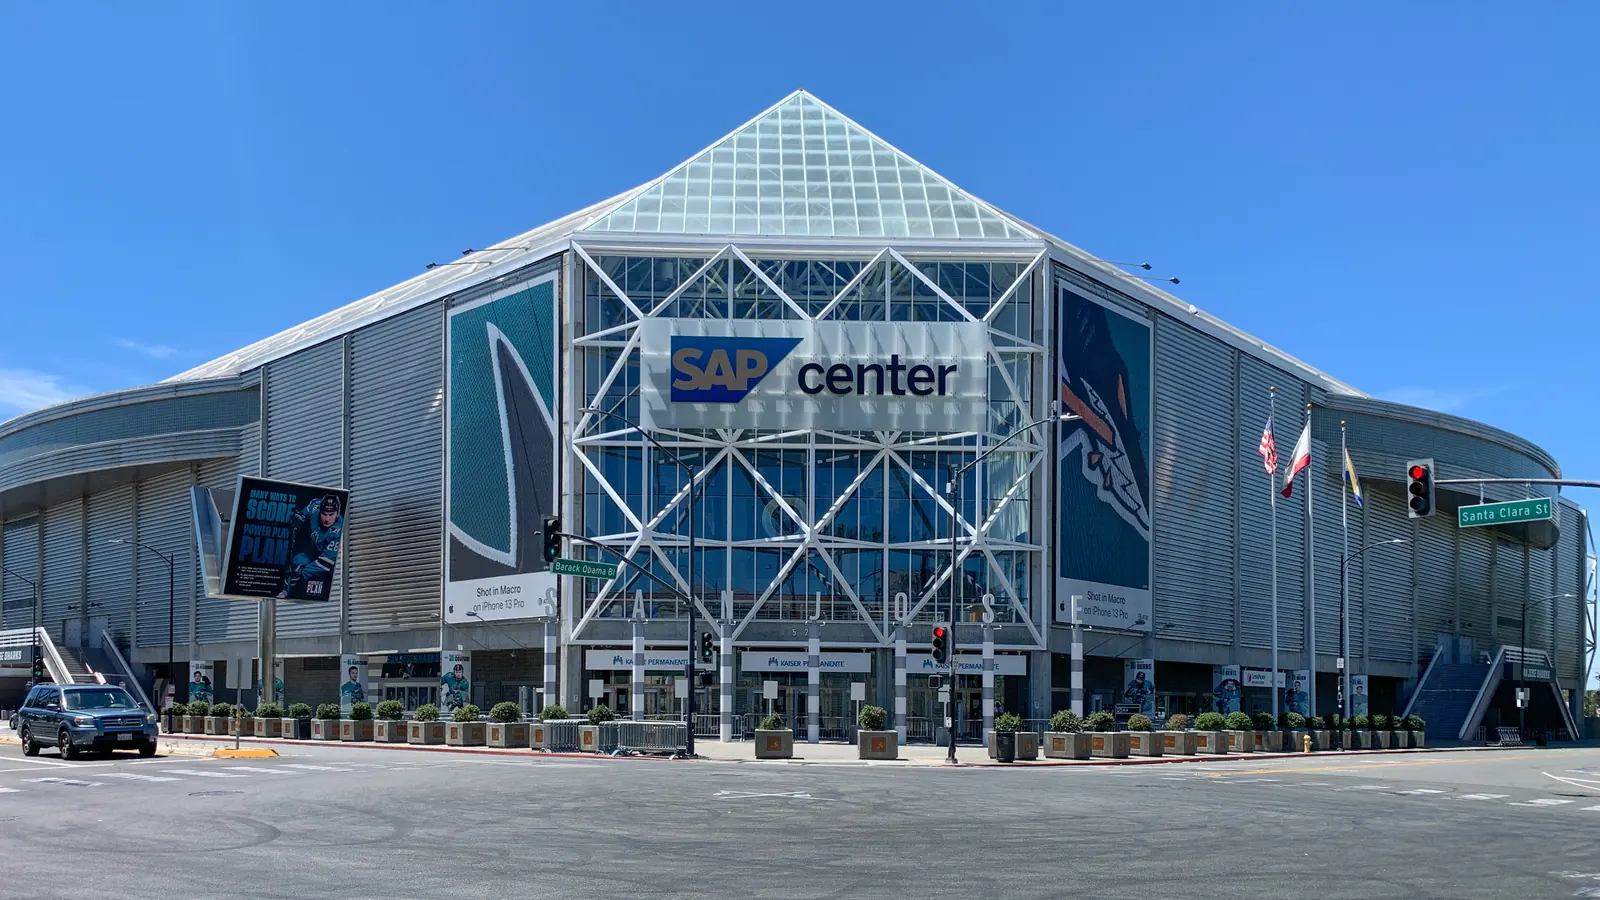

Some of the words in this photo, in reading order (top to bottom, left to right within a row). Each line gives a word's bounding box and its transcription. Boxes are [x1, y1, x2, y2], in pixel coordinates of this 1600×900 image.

[672, 348, 768, 391] SAP
[797, 354, 957, 396] center
[250, 489, 269, 499] MANY
[270, 491, 287, 502] WAYS
[288, 494, 297, 503] TO
[1462, 510, 1494, 522] Santa
[1500, 507, 1530, 518] Clara
[1535, 503, 1548, 515] St
[243, 523, 271, 537] POWER
[238, 535, 289, 565] PLAN
[555, 561, 580, 572] Barack
[582, 565, 607, 575] Obama
[607, 567, 615, 576] Bl
[476, 587, 492, 598] Shot
[492, 586, 499, 596] in
[500, 585, 521, 595] Macro
[1087, 590, 1101, 601] Shot
[1101, 592, 1107, 603] in
[1108, 593, 1126, 605] Macro
[473, 603, 481, 612] on
[482, 601, 504, 612] iPhone
[505, 599, 512, 609] 13
[513, 599, 525, 609] Pro
[1083, 606, 1092, 616] on
[1092, 605, 1111, 618] iPhone
[1112, 608, 1118, 618] 13
[1119, 609, 1129, 620] Pro
